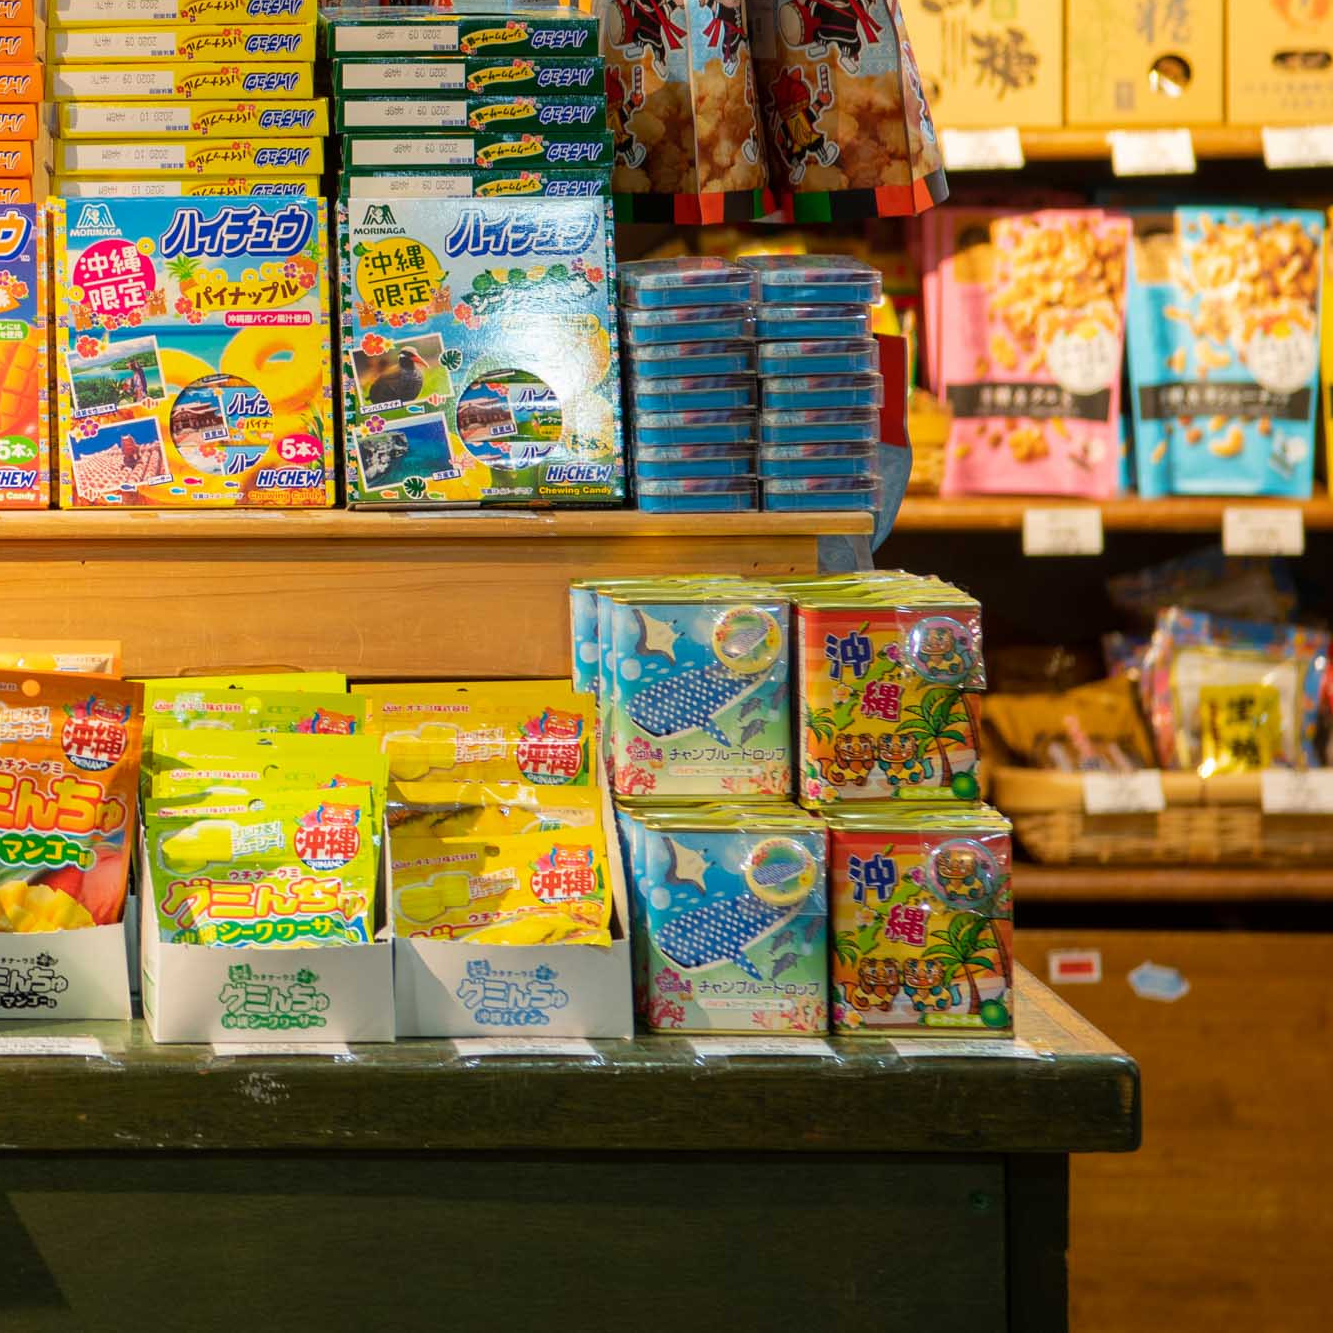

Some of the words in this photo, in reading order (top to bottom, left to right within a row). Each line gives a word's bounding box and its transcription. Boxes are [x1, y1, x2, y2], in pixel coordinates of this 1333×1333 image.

[69, 227, 123, 237] MORINAGA
[161, 206, 313, 259] ハイチュウ
[353, 227, 406, 235] MORINAGA
[445, 208, 601, 258] ハイチュウ
[79, 247, 141, 279] 沖縄
[365, 244, 426, 276] 沖縄
[88, 280, 146, 312] 限定
[374, 277, 431, 308] 限定
[669, 746, 787, 762] チャンプルードロップ
[698, 980, 820, 996] チャンプルードロップ
